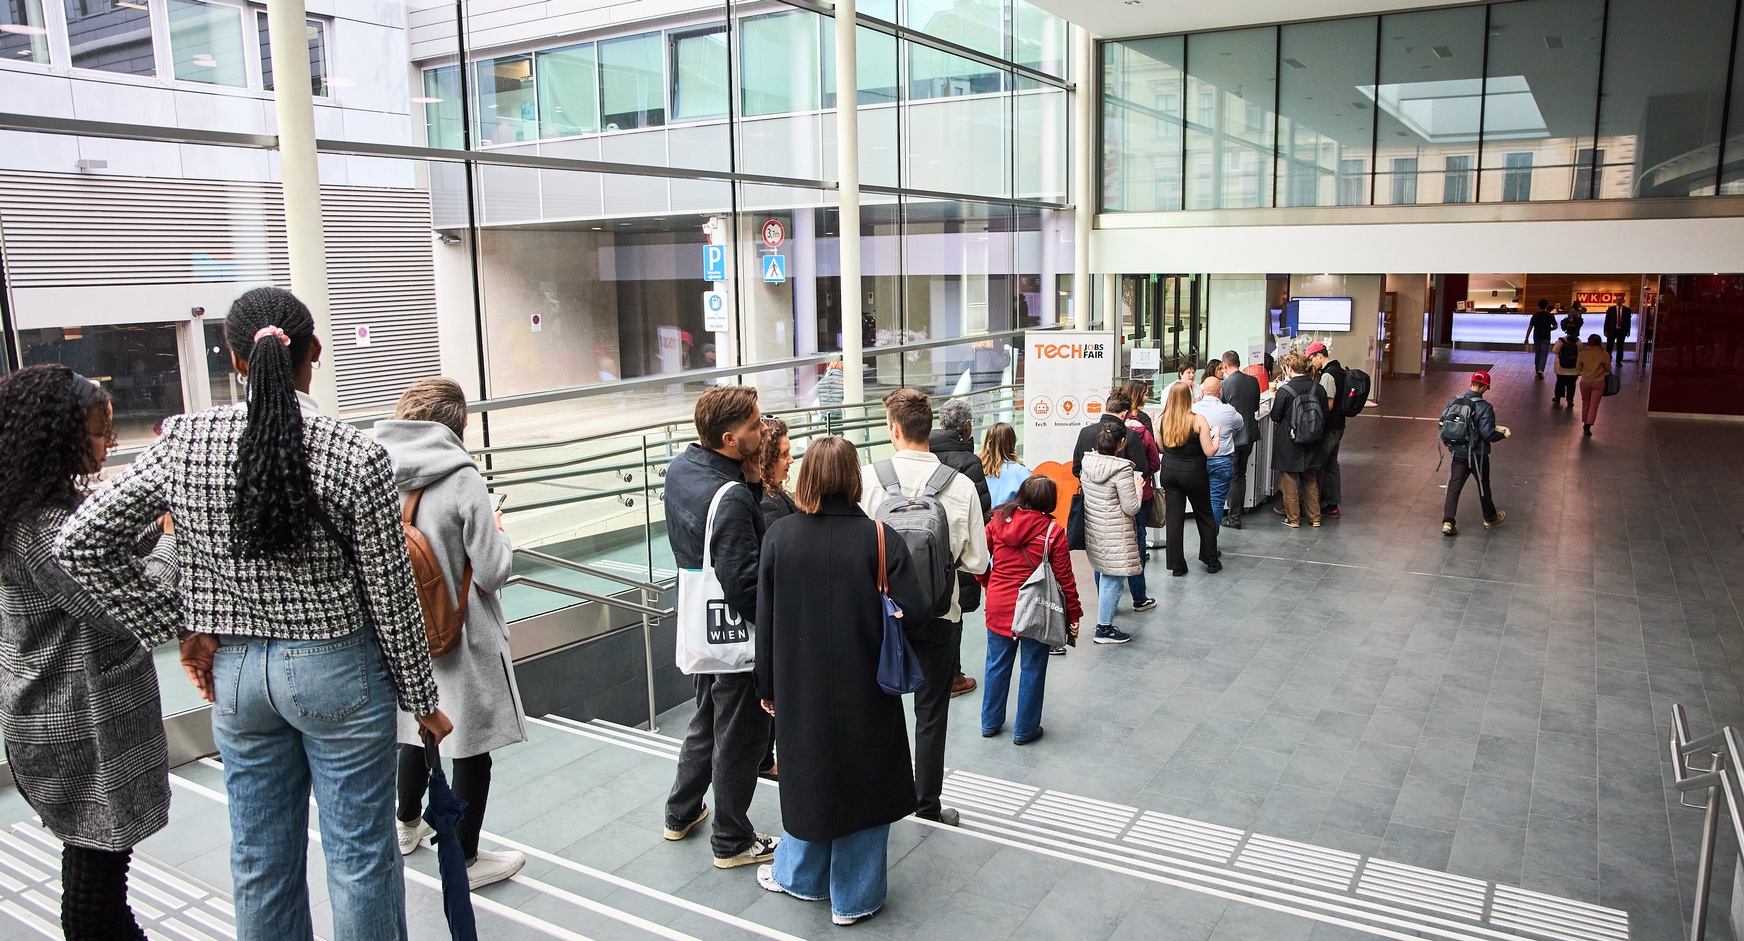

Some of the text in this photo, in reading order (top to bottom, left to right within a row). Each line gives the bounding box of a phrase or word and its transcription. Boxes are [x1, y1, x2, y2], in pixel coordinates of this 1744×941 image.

[709, 247, 722, 271] P
[1577, 293, 1612, 302] WKO
[1083, 351, 1104, 359] FAIR
[708, 603, 742, 627] TU
[710, 629, 746, 640] WIEN
